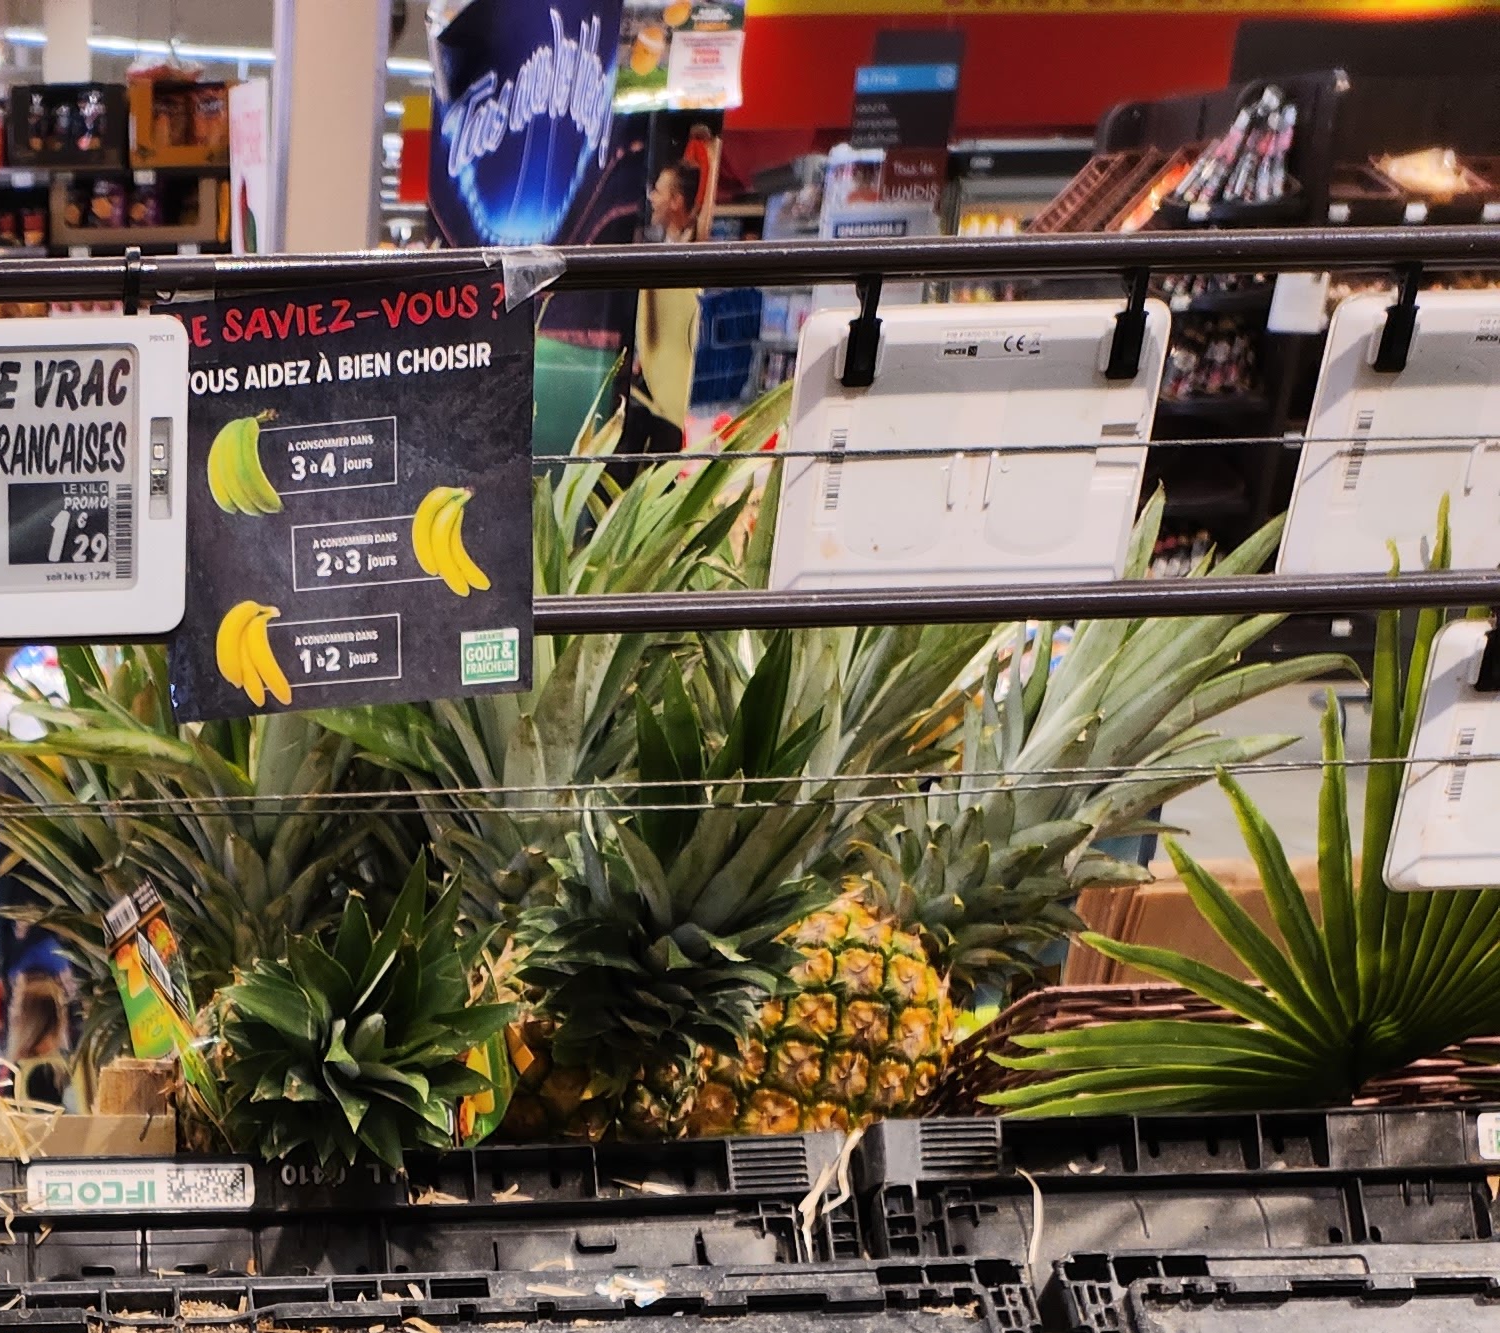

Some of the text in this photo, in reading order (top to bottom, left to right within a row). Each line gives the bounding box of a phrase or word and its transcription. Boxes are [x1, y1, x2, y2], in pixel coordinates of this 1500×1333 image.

[187, 314, 212, 348] E
[221, 283, 479, 344] SAVIEZ-VOUS
[187, 342, 493, 397] OUS AIDEZ À BIEN CHOISIR
[34, 358, 132, 411] VRAC
[295, 436, 350, 452] CONSOMMER
[350, 434, 375, 447] DANS
[291, 455, 306, 481] 3
[320, 452, 337, 478] 4
[343, 457, 374, 475] jours
[62, 483, 108, 495] LE KILO
[63, 495, 109, 511] PROMO
[48, 509, 71, 563] 1
[72, 532, 108, 563] 29
[320, 534, 374, 549] CONSOMMER
[374, 532, 399, 544] DANS
[316, 551, 333, 577] 2
[345, 549, 361, 574] 3
[367, 553, 398, 572] jours
[302, 631, 355, 646] CONSOMMER
[355, 629, 379, 642] DANS
[299, 648, 312, 674] 1
[325, 646, 341, 672] 2
[348, 649, 379, 668] jours
[466, 641, 514, 662] GOÛT &
[76, 1180, 156, 1205] IFCO
